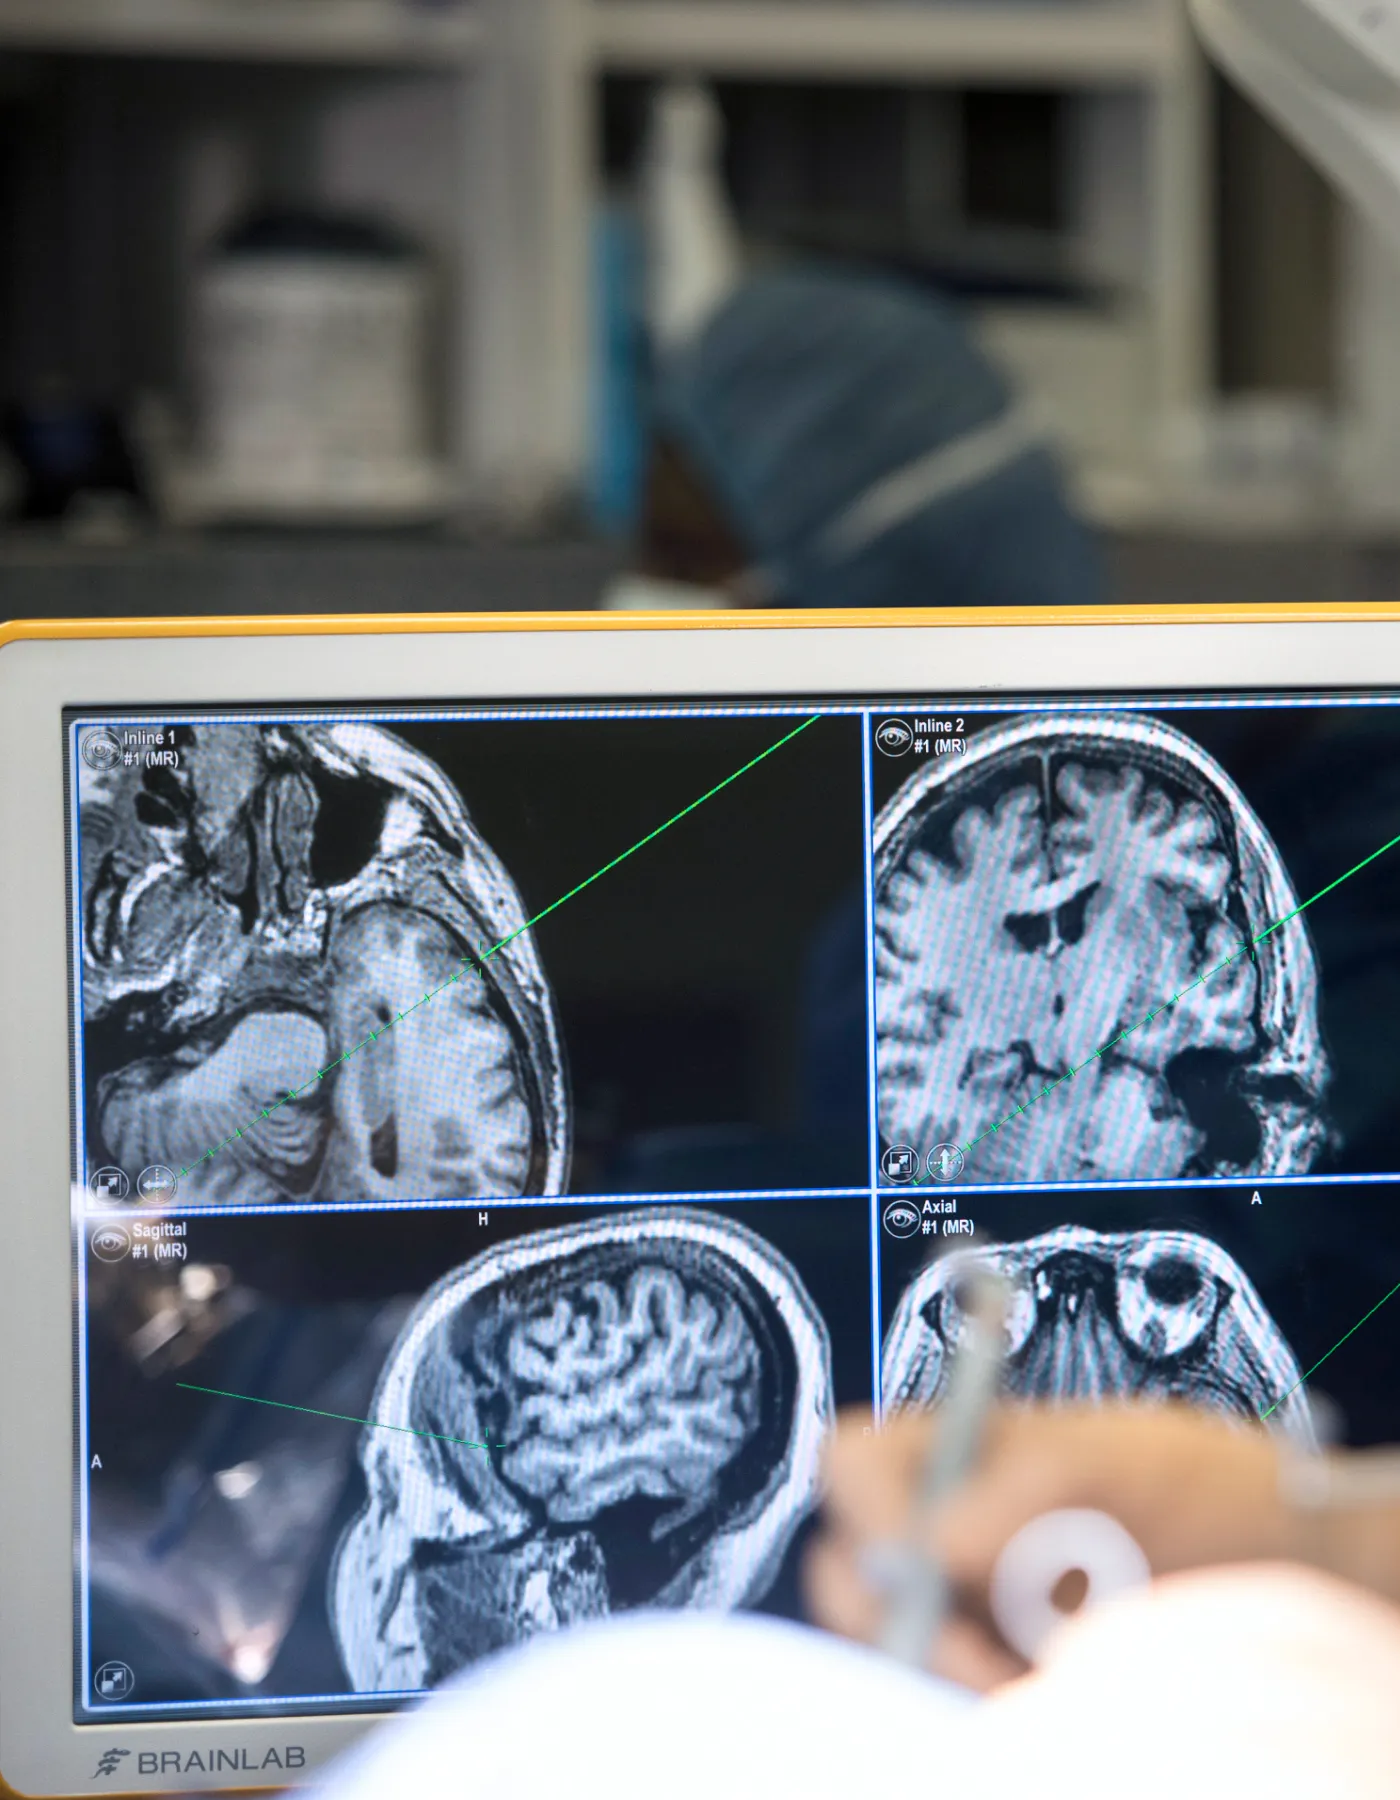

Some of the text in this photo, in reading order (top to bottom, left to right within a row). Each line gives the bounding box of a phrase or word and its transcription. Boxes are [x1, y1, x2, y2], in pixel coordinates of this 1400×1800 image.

[915, 718, 965, 732] Inline 2
[124, 730, 175, 745] Inline 1
[914, 738, 967, 755] #1 (MR)
[124, 751, 179, 769] #1 (MR)
[1251, 1190, 1262, 1205] A
[922, 1199, 957, 1214] Axial
[478, 1211, 489, 1226] H
[133, 1221, 187, 1240] Sagittal
[922, 1219, 975, 1237] #1 (MR)
[132, 1243, 187, 1262] #1 (MR)
[91, 1454, 102, 1469] A
[138, 1746, 306, 1775] BRAINLAB
